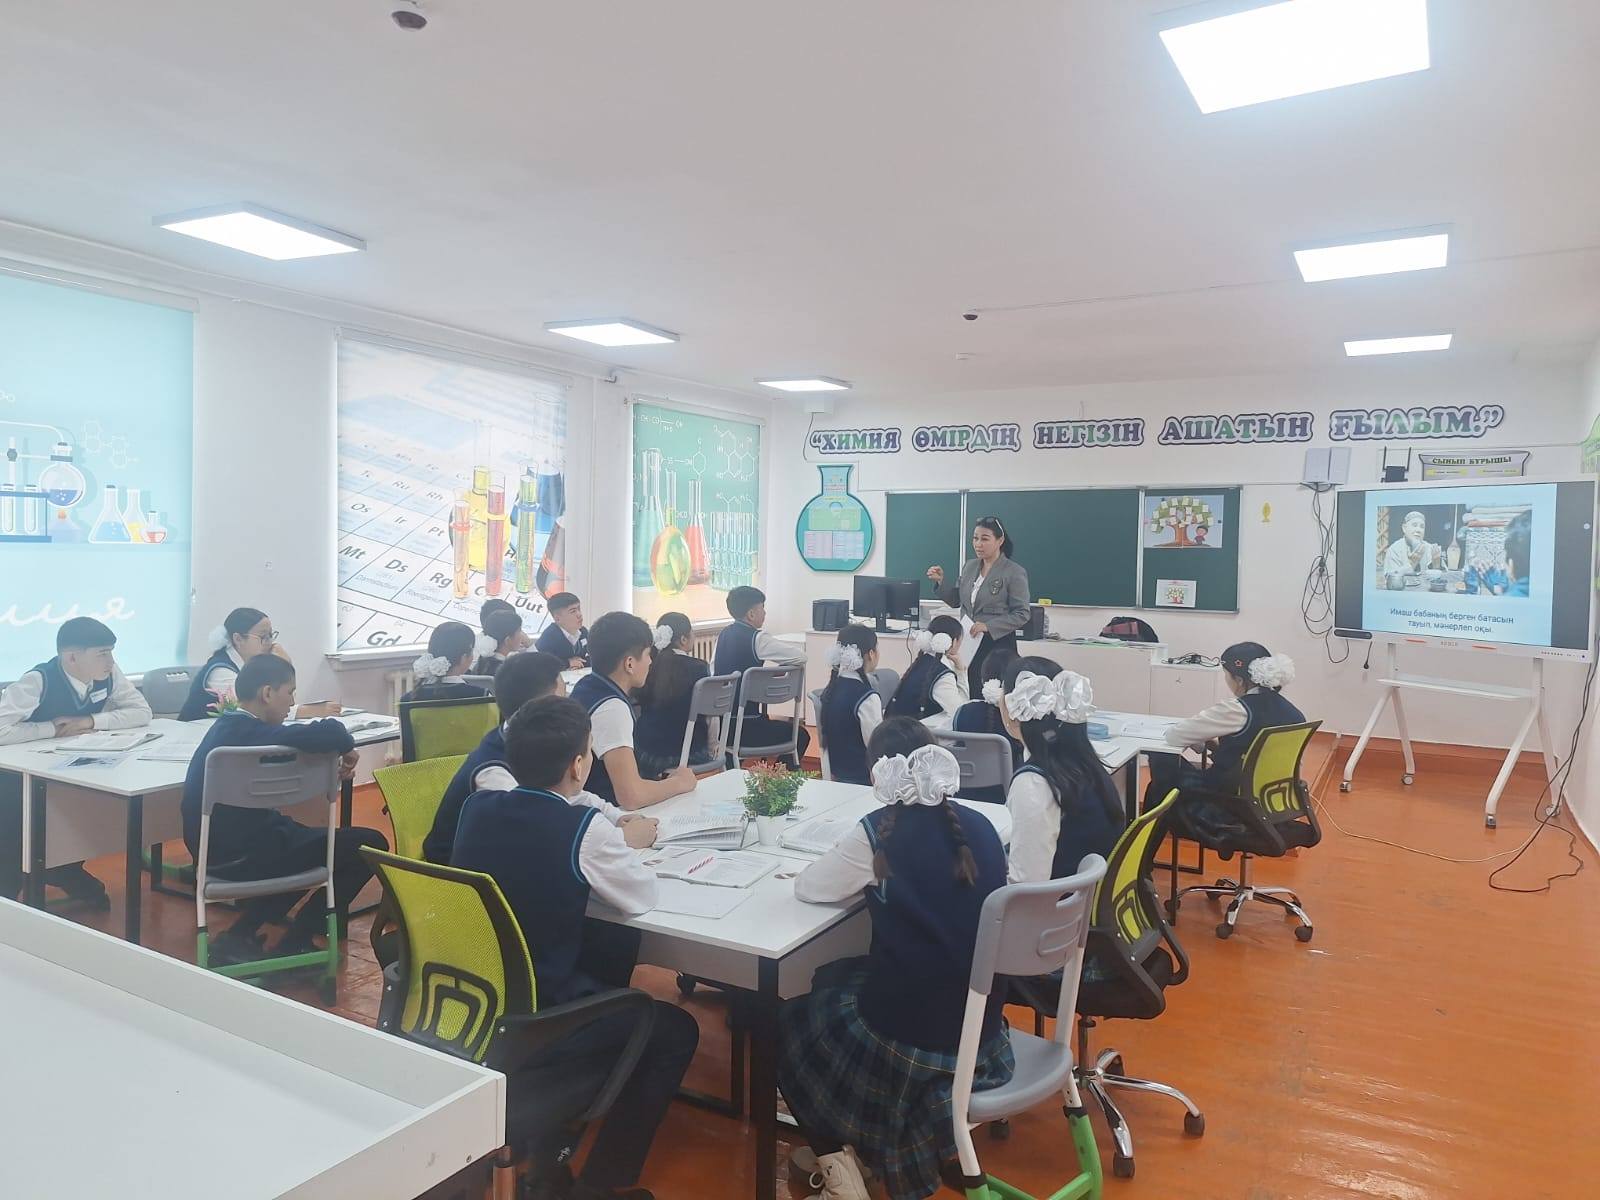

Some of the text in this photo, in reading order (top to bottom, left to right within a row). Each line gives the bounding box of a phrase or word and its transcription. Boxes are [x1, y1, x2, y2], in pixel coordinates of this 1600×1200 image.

[1036, 420, 1142, 447] НЕГІЗІН
[1161, 415, 1311, 441] АШАТЫН
[350, 503, 445, 537] Os Ir Pt
[338, 545, 366, 560] Mt
[384, 559, 409, 573] Ds
[429, 572, 453, 588] Rg
[1448, 611, 1476, 622] берген
[1477, 613, 1515, 624] батасын
[366, 631, 403, 647] Gd
